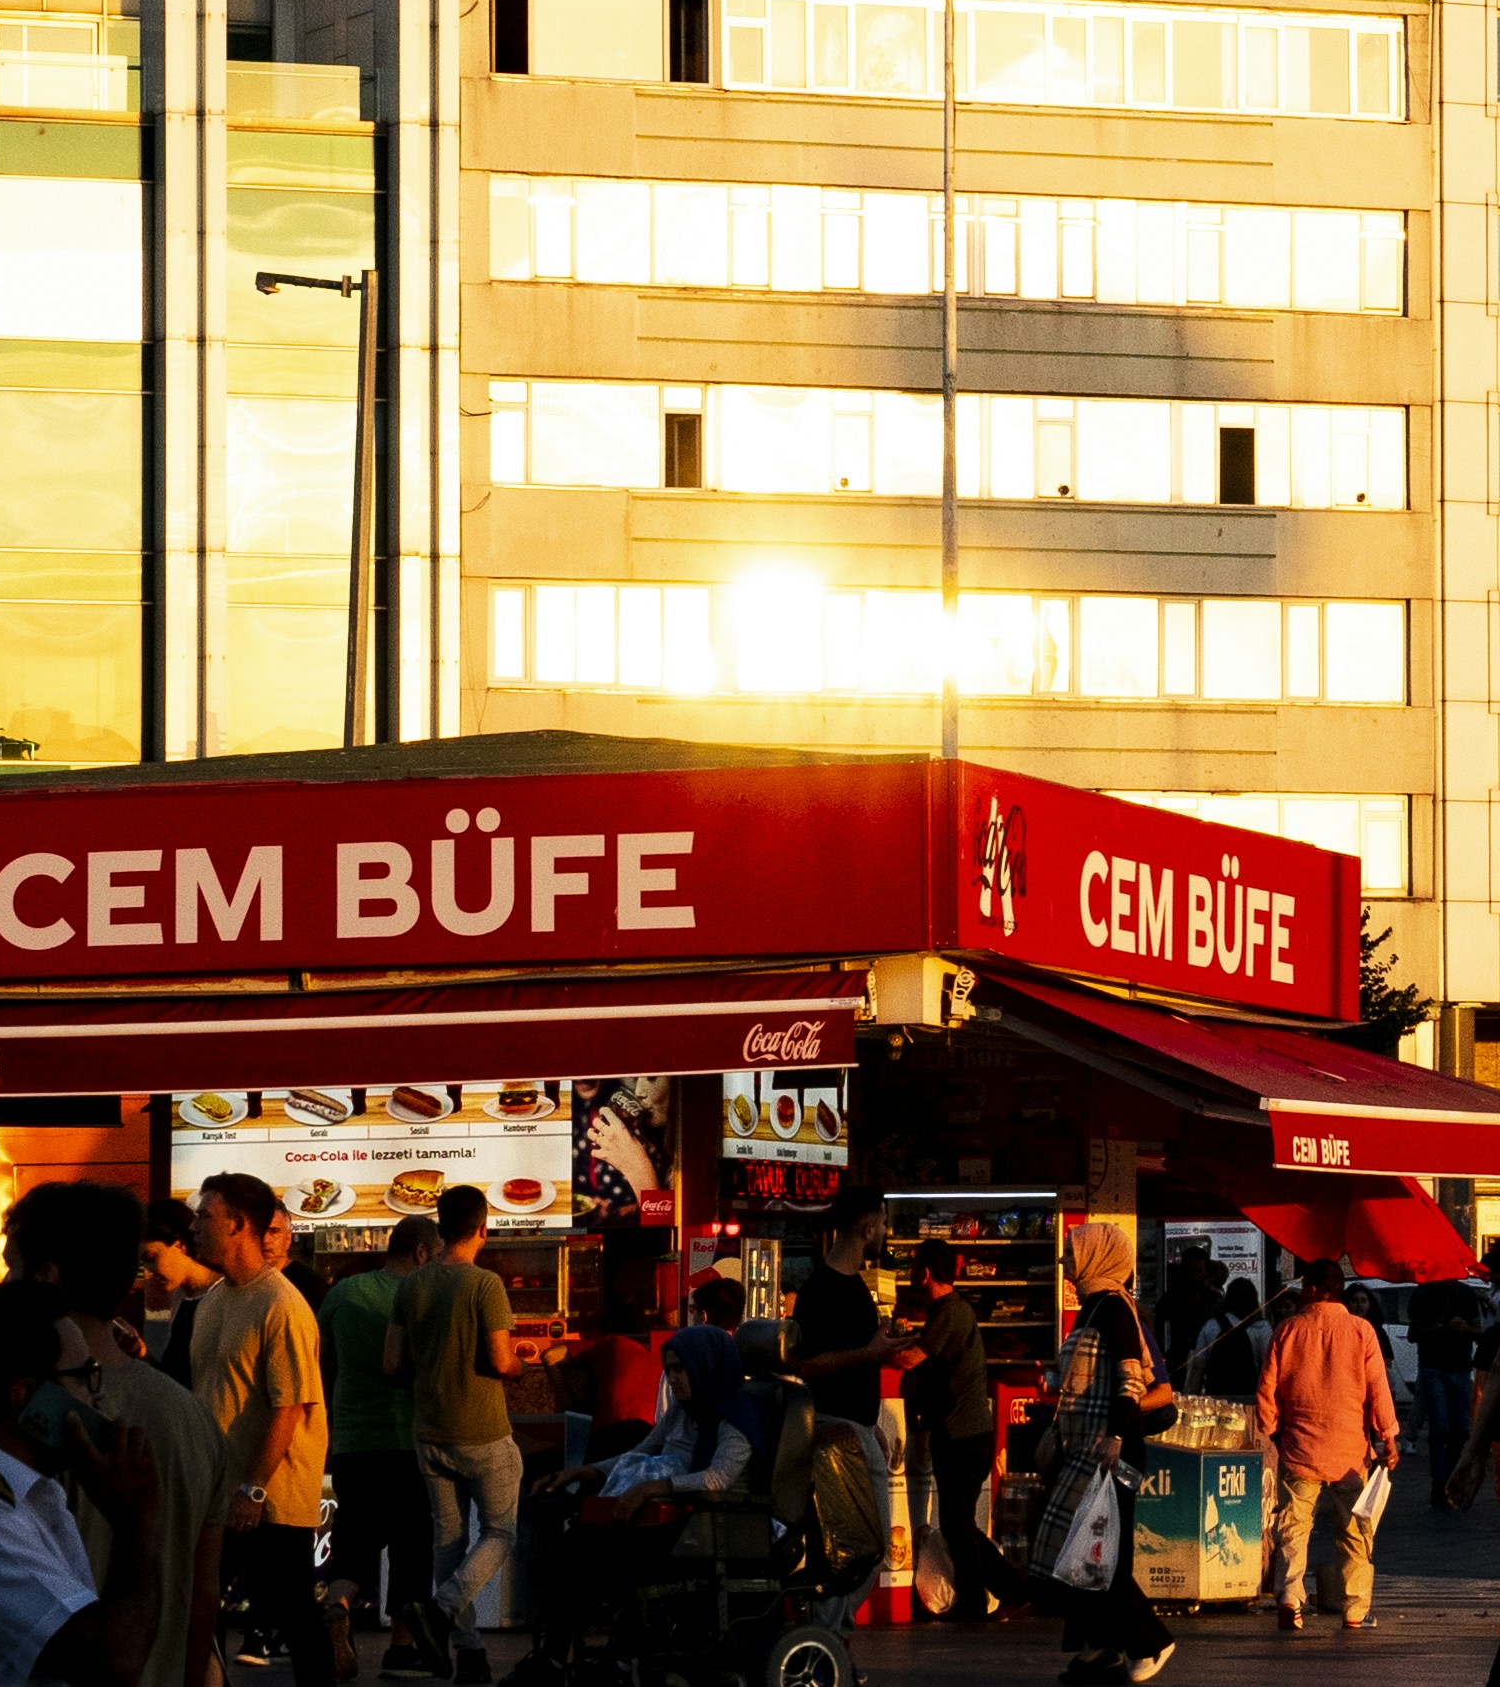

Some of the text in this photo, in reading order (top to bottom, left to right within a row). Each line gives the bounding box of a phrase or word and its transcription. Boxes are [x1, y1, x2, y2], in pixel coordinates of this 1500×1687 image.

[336, 807, 697, 939] BÜFE
[1080, 850, 1296, 985] CEM BÜFE
[742, 1020, 826, 1063] Coca-Cola
[352, 1150, 368, 1161] ile
[371, 1149, 412, 1161] lezzeti
[416, 1147, 477, 1159] tamamla!
[1293, 1133, 1351, 1166] CEM BÜFE
[693, 1240, 715, 1253] Red
[1218, 1465, 1246, 1498] Erikli
